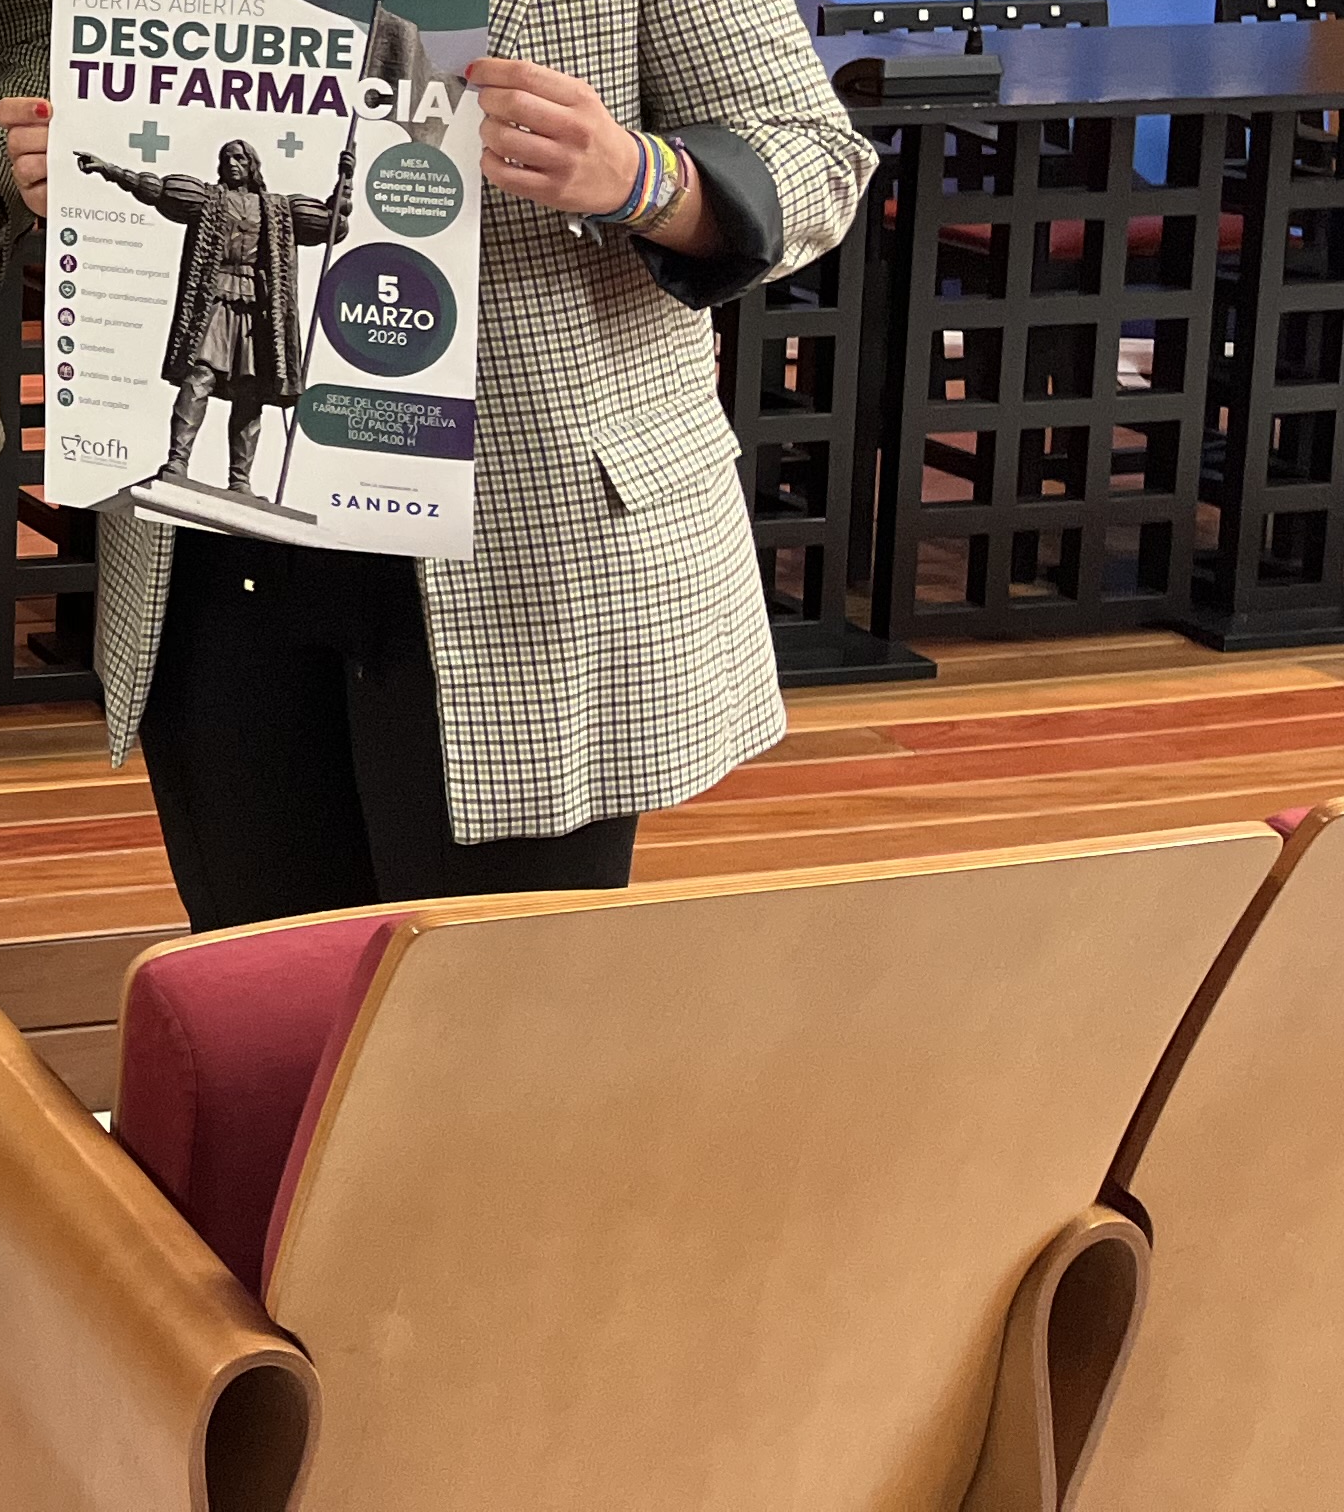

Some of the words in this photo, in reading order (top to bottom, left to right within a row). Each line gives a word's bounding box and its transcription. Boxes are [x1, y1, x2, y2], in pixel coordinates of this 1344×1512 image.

[72, 15, 354, 70] DESCUBRE
[69, 60, 136, 102] TU
[149, 65, 456, 125] FARMACIA
[401, 158, 430, 169] MESA
[380, 170, 450, 183] INFORMATIVA
[373, 181, 413, 192] Conoce
[415, 184, 426, 193] la
[428, 185, 456, 195] labor
[374, 193, 388, 201] de
[390, 194, 401, 202] la
[403, 195, 454, 206] Farmacia
[60, 206, 126, 224] SERVICIOS
[382, 204, 447, 217] Hospitalaria
[378, 274, 399, 304] 5
[340, 302, 435, 331] MARZO
[368, 329, 407, 346] 2026
[326, 394, 351, 405] SEDE
[354, 397, 372, 408] DEL
[375, 400, 424, 415] COLEGIO
[428, 406, 442, 417] DE
[398, 412, 411, 424] DE
[414, 414, 456, 428] HUELVA
[81, 438, 128, 460] cofh
[407, 437, 416, 446] H
[331, 493, 440, 517] SANDOZ
